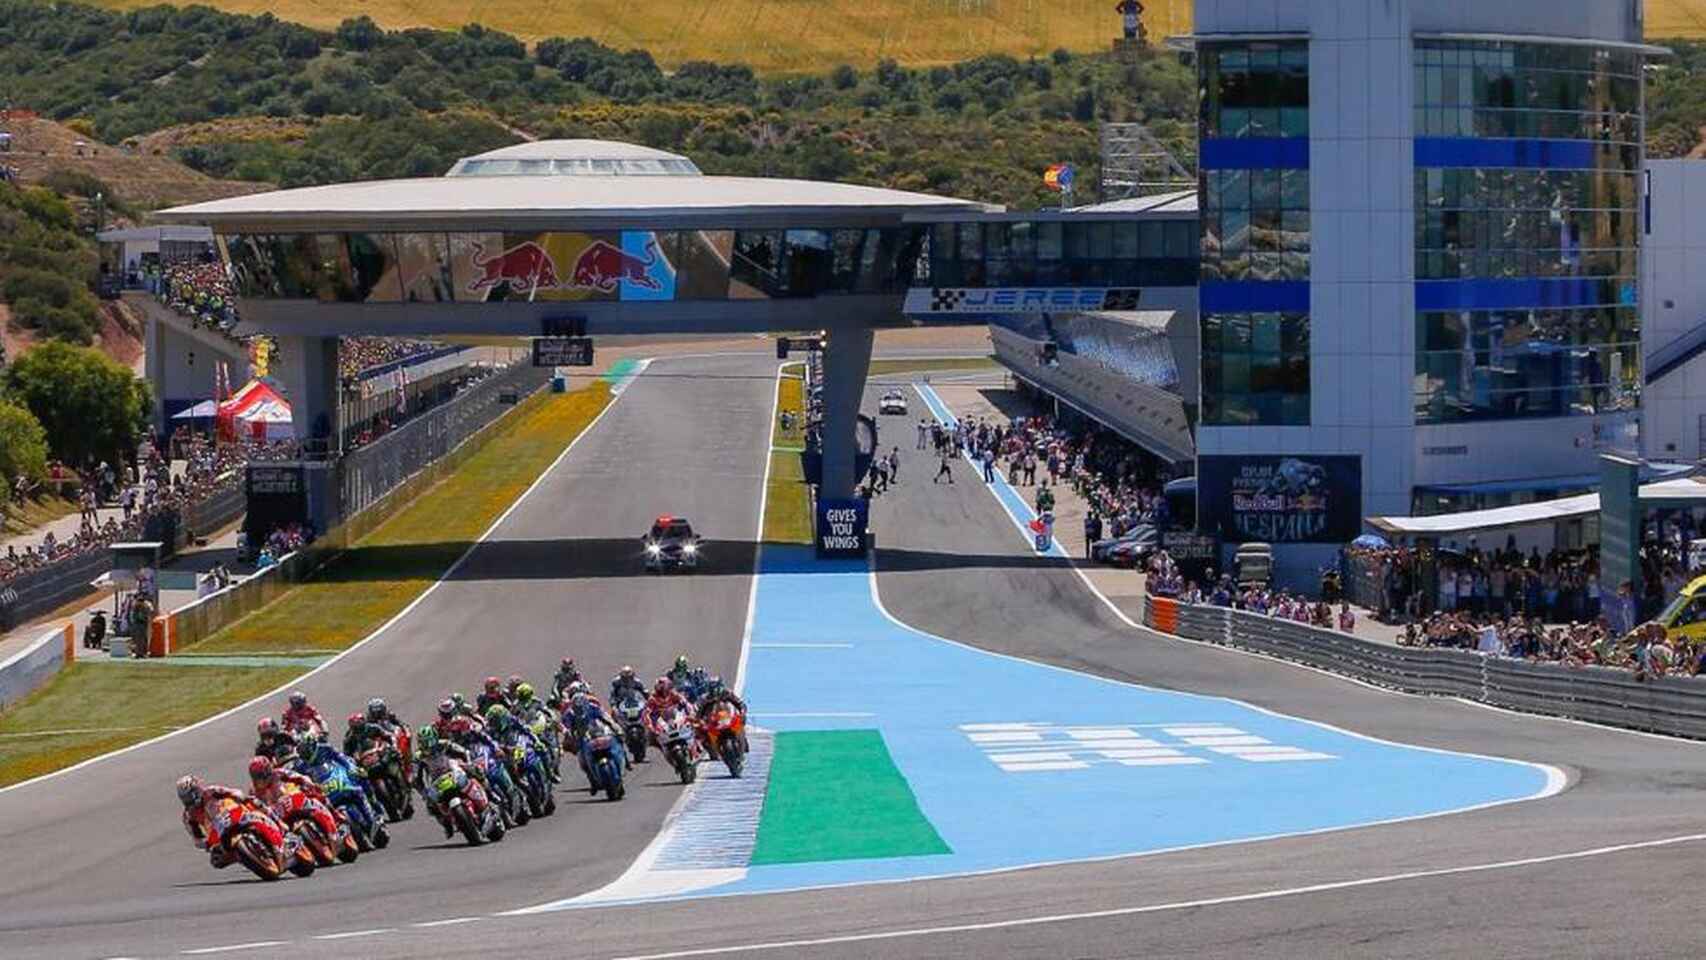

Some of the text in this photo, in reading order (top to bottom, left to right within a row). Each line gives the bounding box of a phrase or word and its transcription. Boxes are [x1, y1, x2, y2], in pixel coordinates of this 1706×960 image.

[826, 509, 857, 522] GIVES
[830, 523, 853, 535] YOU
[823, 536, 859, 549] WINGS
